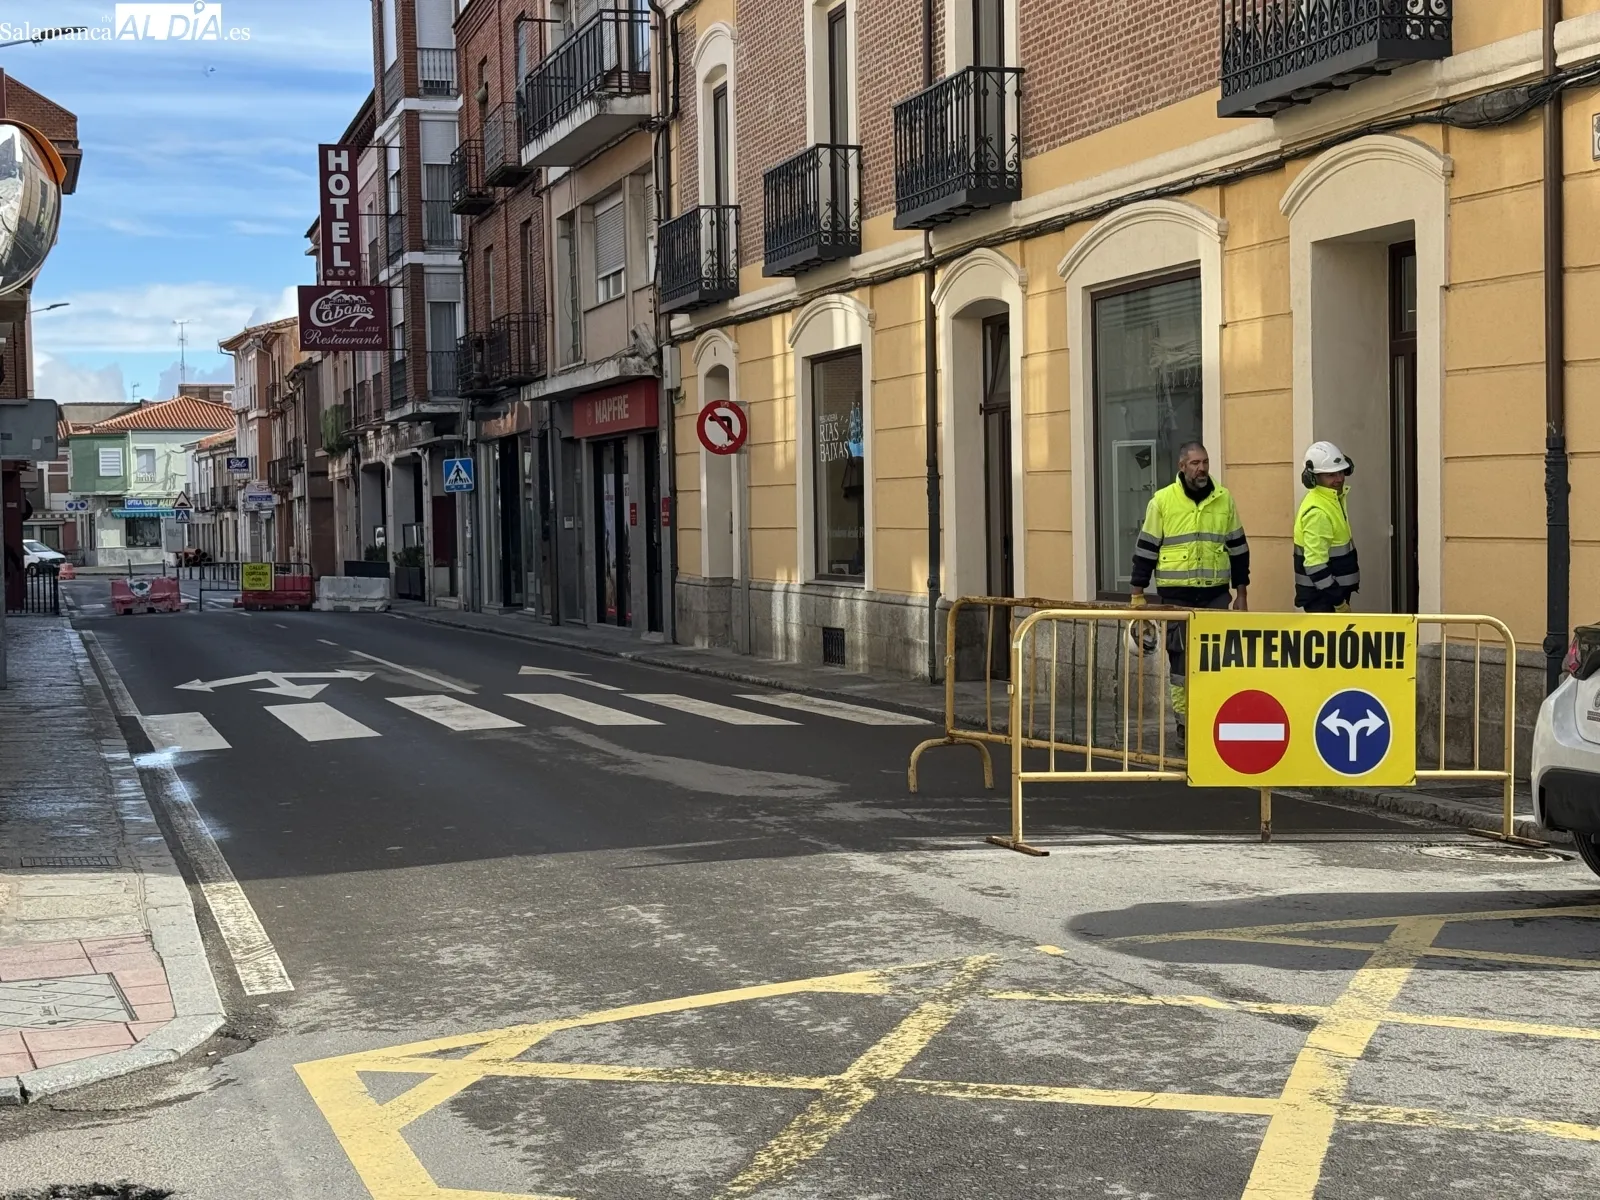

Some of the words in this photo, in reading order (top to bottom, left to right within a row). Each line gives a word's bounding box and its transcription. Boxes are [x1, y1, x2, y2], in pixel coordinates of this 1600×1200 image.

[327, 149, 351, 267] HOTEL
[310, 289, 375, 327] Cabañas
[304, 329, 382, 345] Restaurante
[595, 394, 629, 424] MAPFRE
[820, 441, 849, 462] BAIXAS
[1199, 623, 1406, 672] ¡¡ATENCIÓN!!
